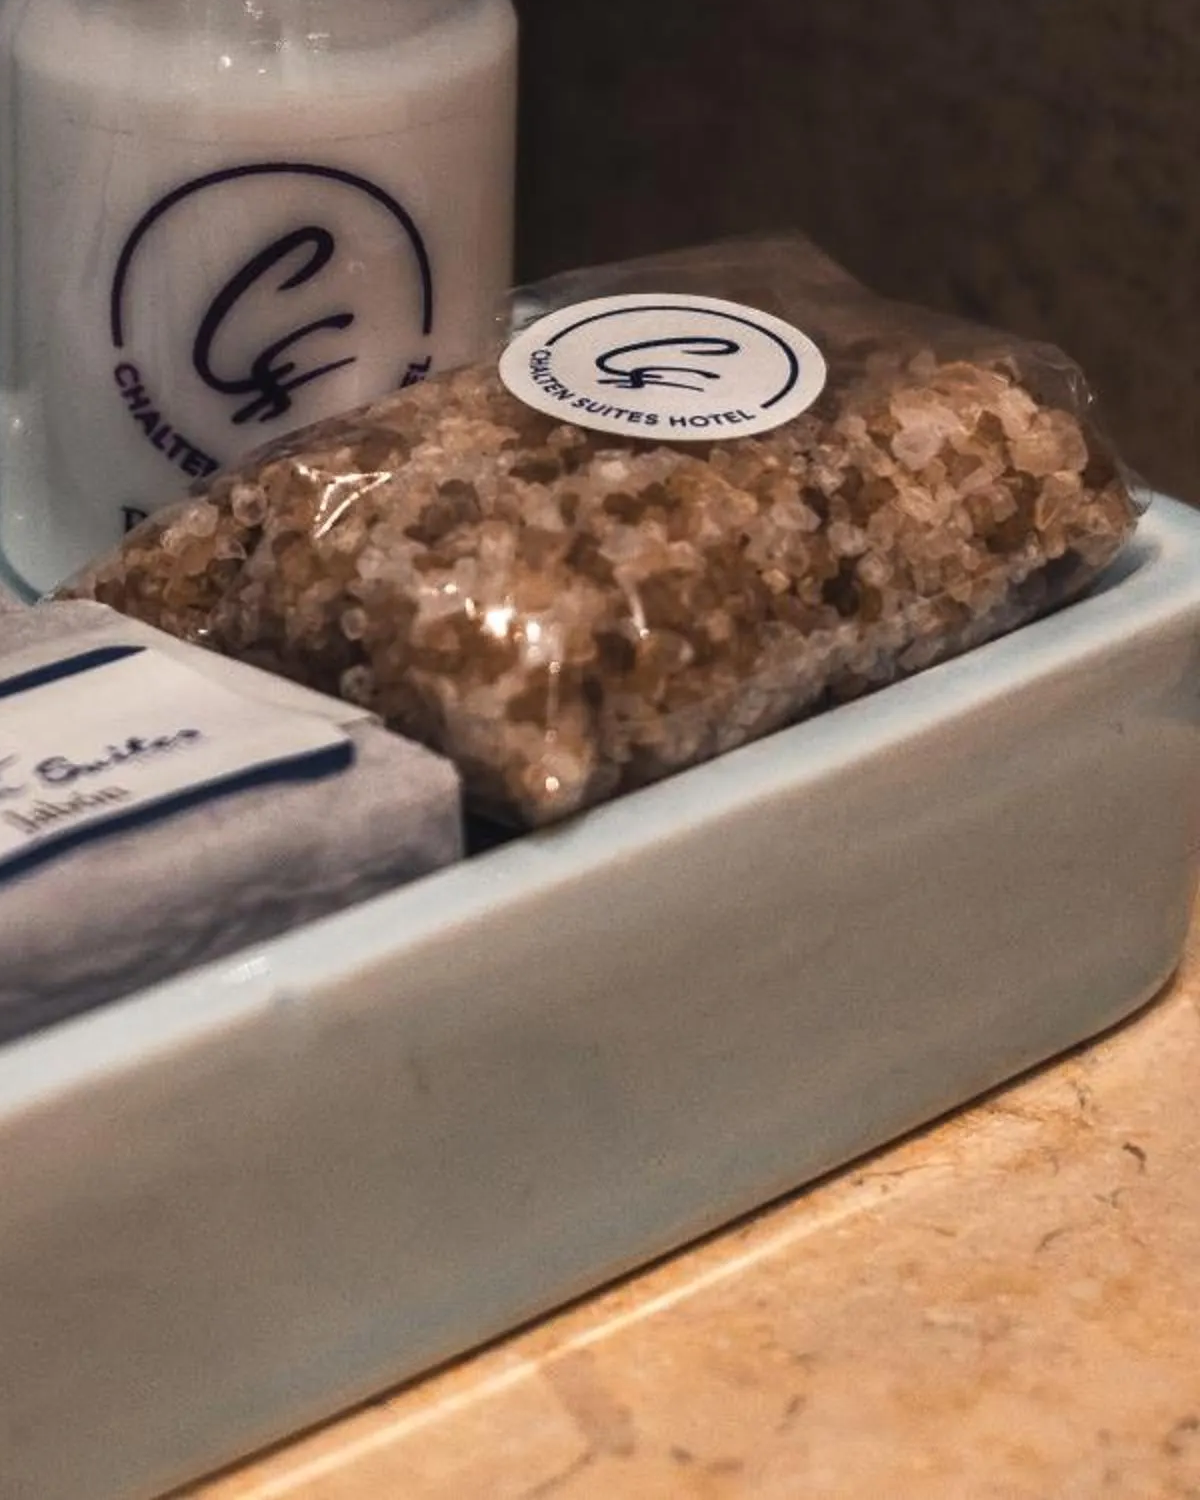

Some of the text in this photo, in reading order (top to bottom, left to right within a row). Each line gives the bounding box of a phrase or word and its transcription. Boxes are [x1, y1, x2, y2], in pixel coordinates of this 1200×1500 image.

[530, 349, 575, 402] CHALTEN
[571, 397, 660, 427] SUITES
[668, 408, 757, 428] HOTEL
